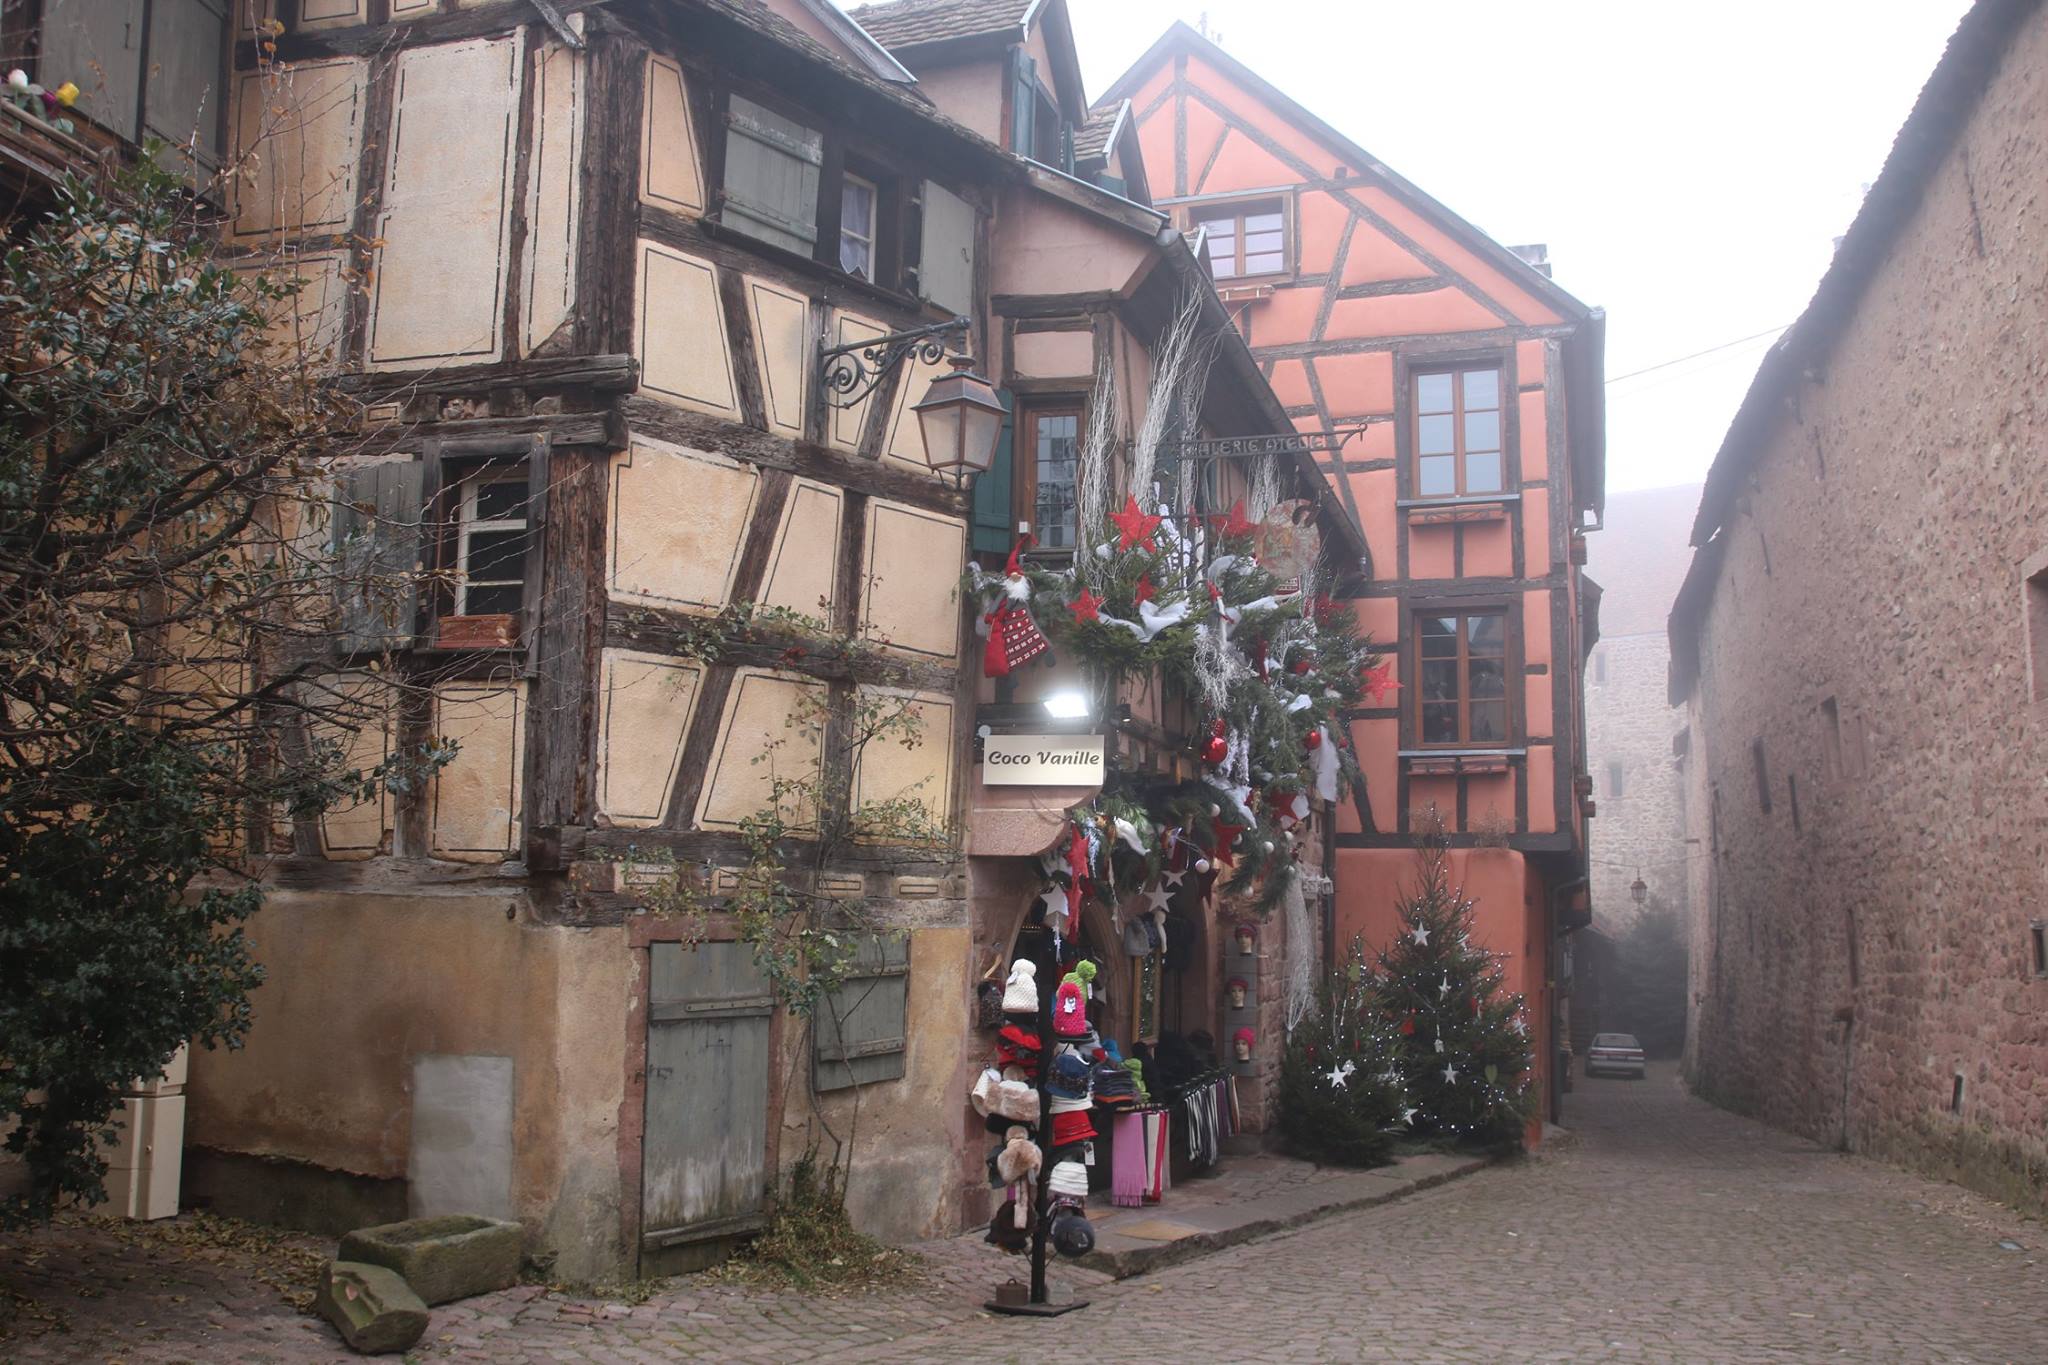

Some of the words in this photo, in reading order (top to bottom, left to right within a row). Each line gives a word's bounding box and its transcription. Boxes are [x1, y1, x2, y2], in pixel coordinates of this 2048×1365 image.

[1189, 439, 1259, 456] ALERIE
[988, 751, 1031, 765] Coco
[1036, 751, 1100, 765] Vanille
